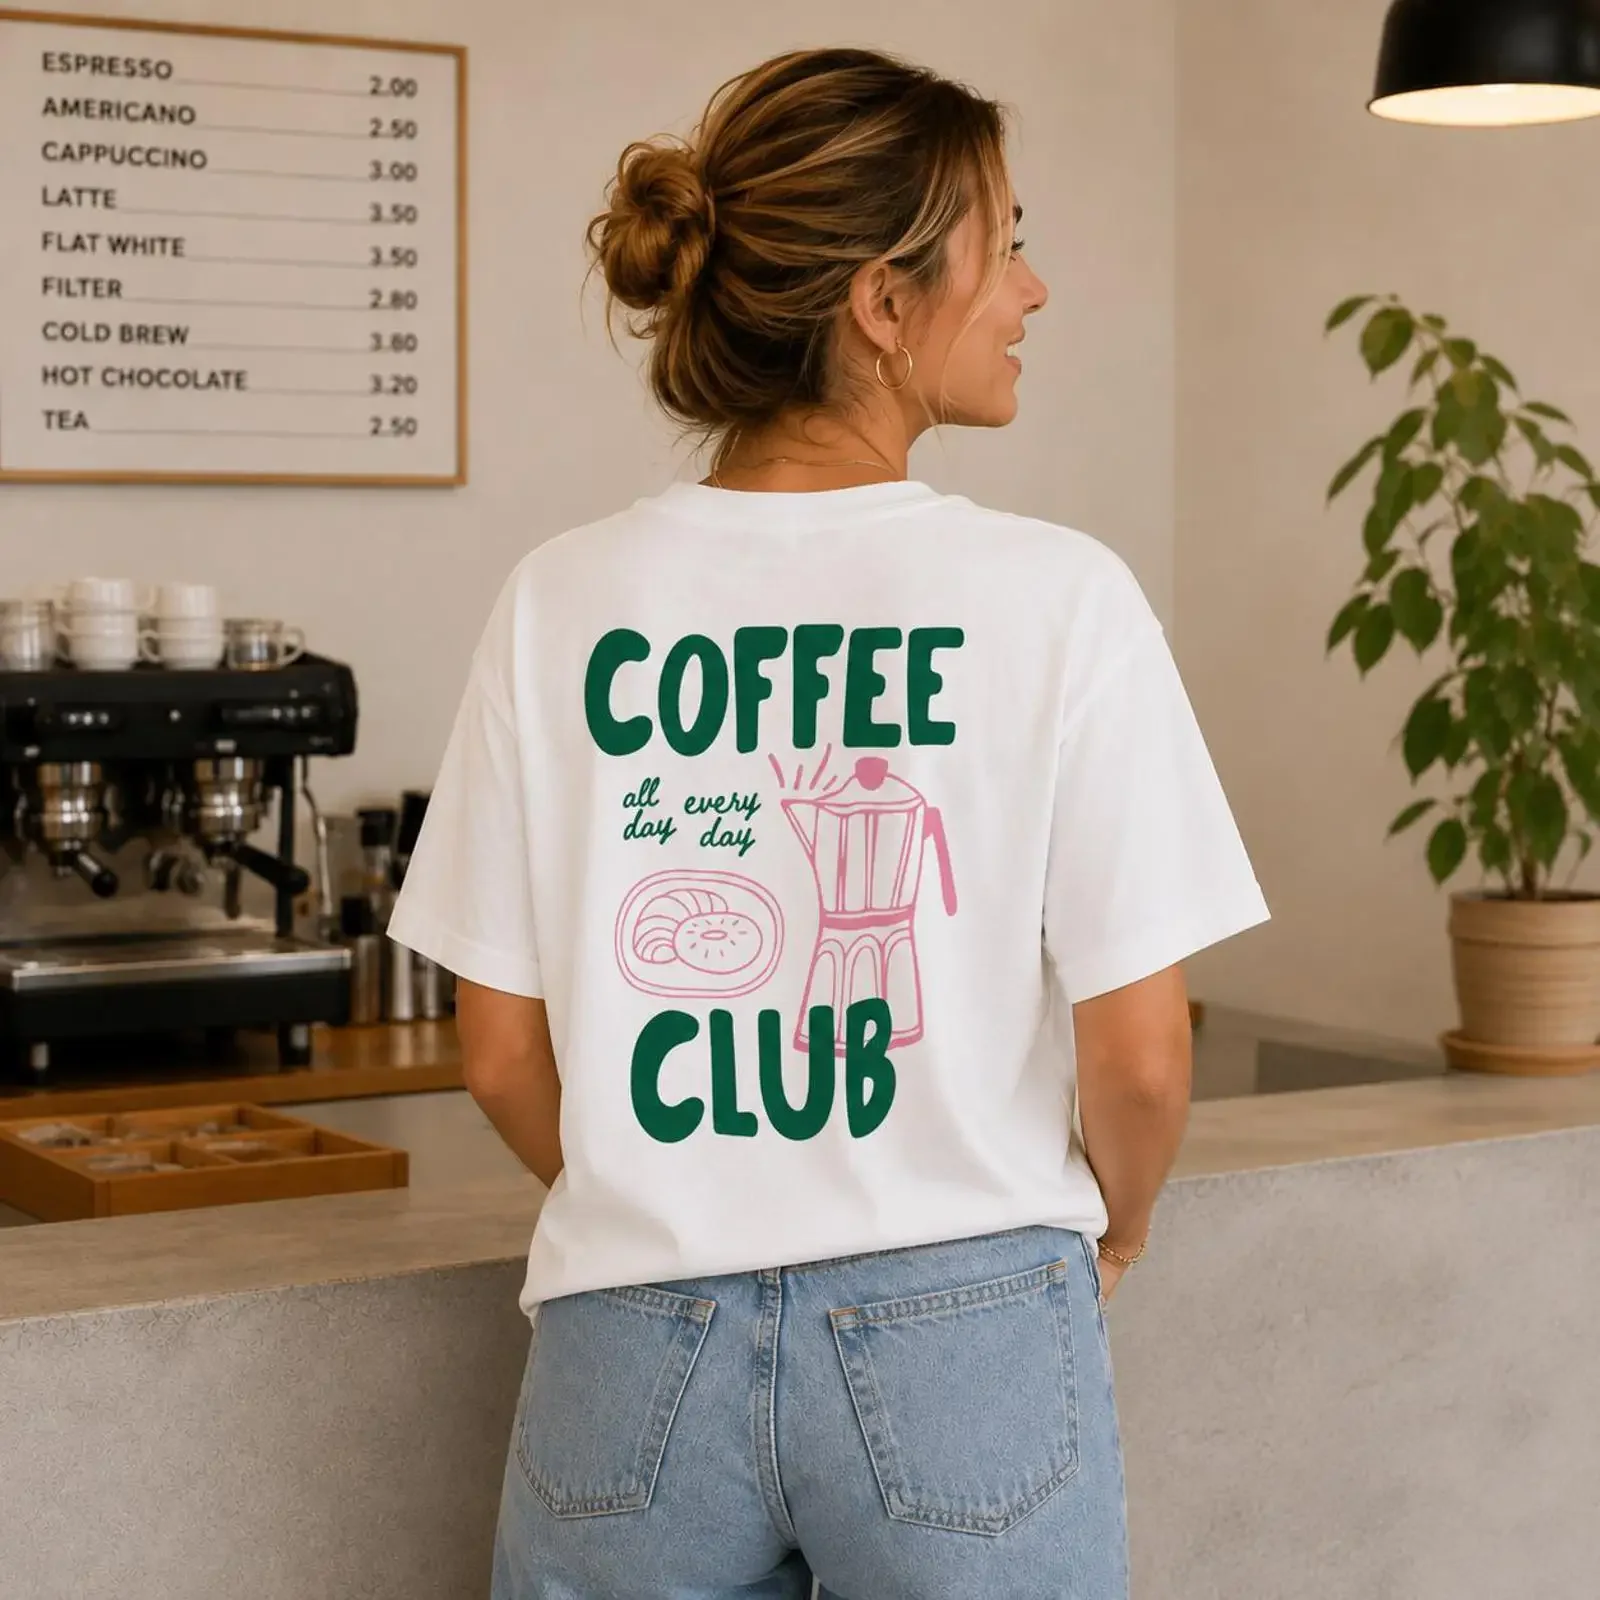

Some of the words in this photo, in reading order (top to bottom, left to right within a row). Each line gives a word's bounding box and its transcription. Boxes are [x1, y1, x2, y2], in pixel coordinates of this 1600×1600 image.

[42, 51, 173, 80] ESPRESSO
[369, 76, 418, 98] 2.00
[42, 97, 196, 125] AMERICANO
[369, 118, 418, 140] 2.50
[41, 141, 207, 170] CAPPUCCINO
[369, 160, 418, 182] 3.00
[42, 187, 117, 209] LATTE
[369, 203, 418, 225] 3.50
[42, 232, 100, 253] FLAT
[107, 234, 185, 258] WHITE
[369, 246, 418, 268] 3.50
[42, 276, 122, 299] FILTER
[369, 289, 418, 310] 2.80
[42, 321, 111, 343] COLD
[119, 323, 189, 346] BREW
[42, 366, 92, 386] HOT
[101, 367, 248, 391] CHOCOLATE
[369, 374, 418, 395] 3.20
[42, 410, 89, 431] TEA
[369, 417, 418, 437] 2.50
[584, 624, 965, 757] COFFEE
[622, 776, 660, 808] all
[684, 792, 761, 821] every
[623, 808, 677, 845] day
[700, 816, 756, 857] day
[630, 996, 896, 1144] CLUB
